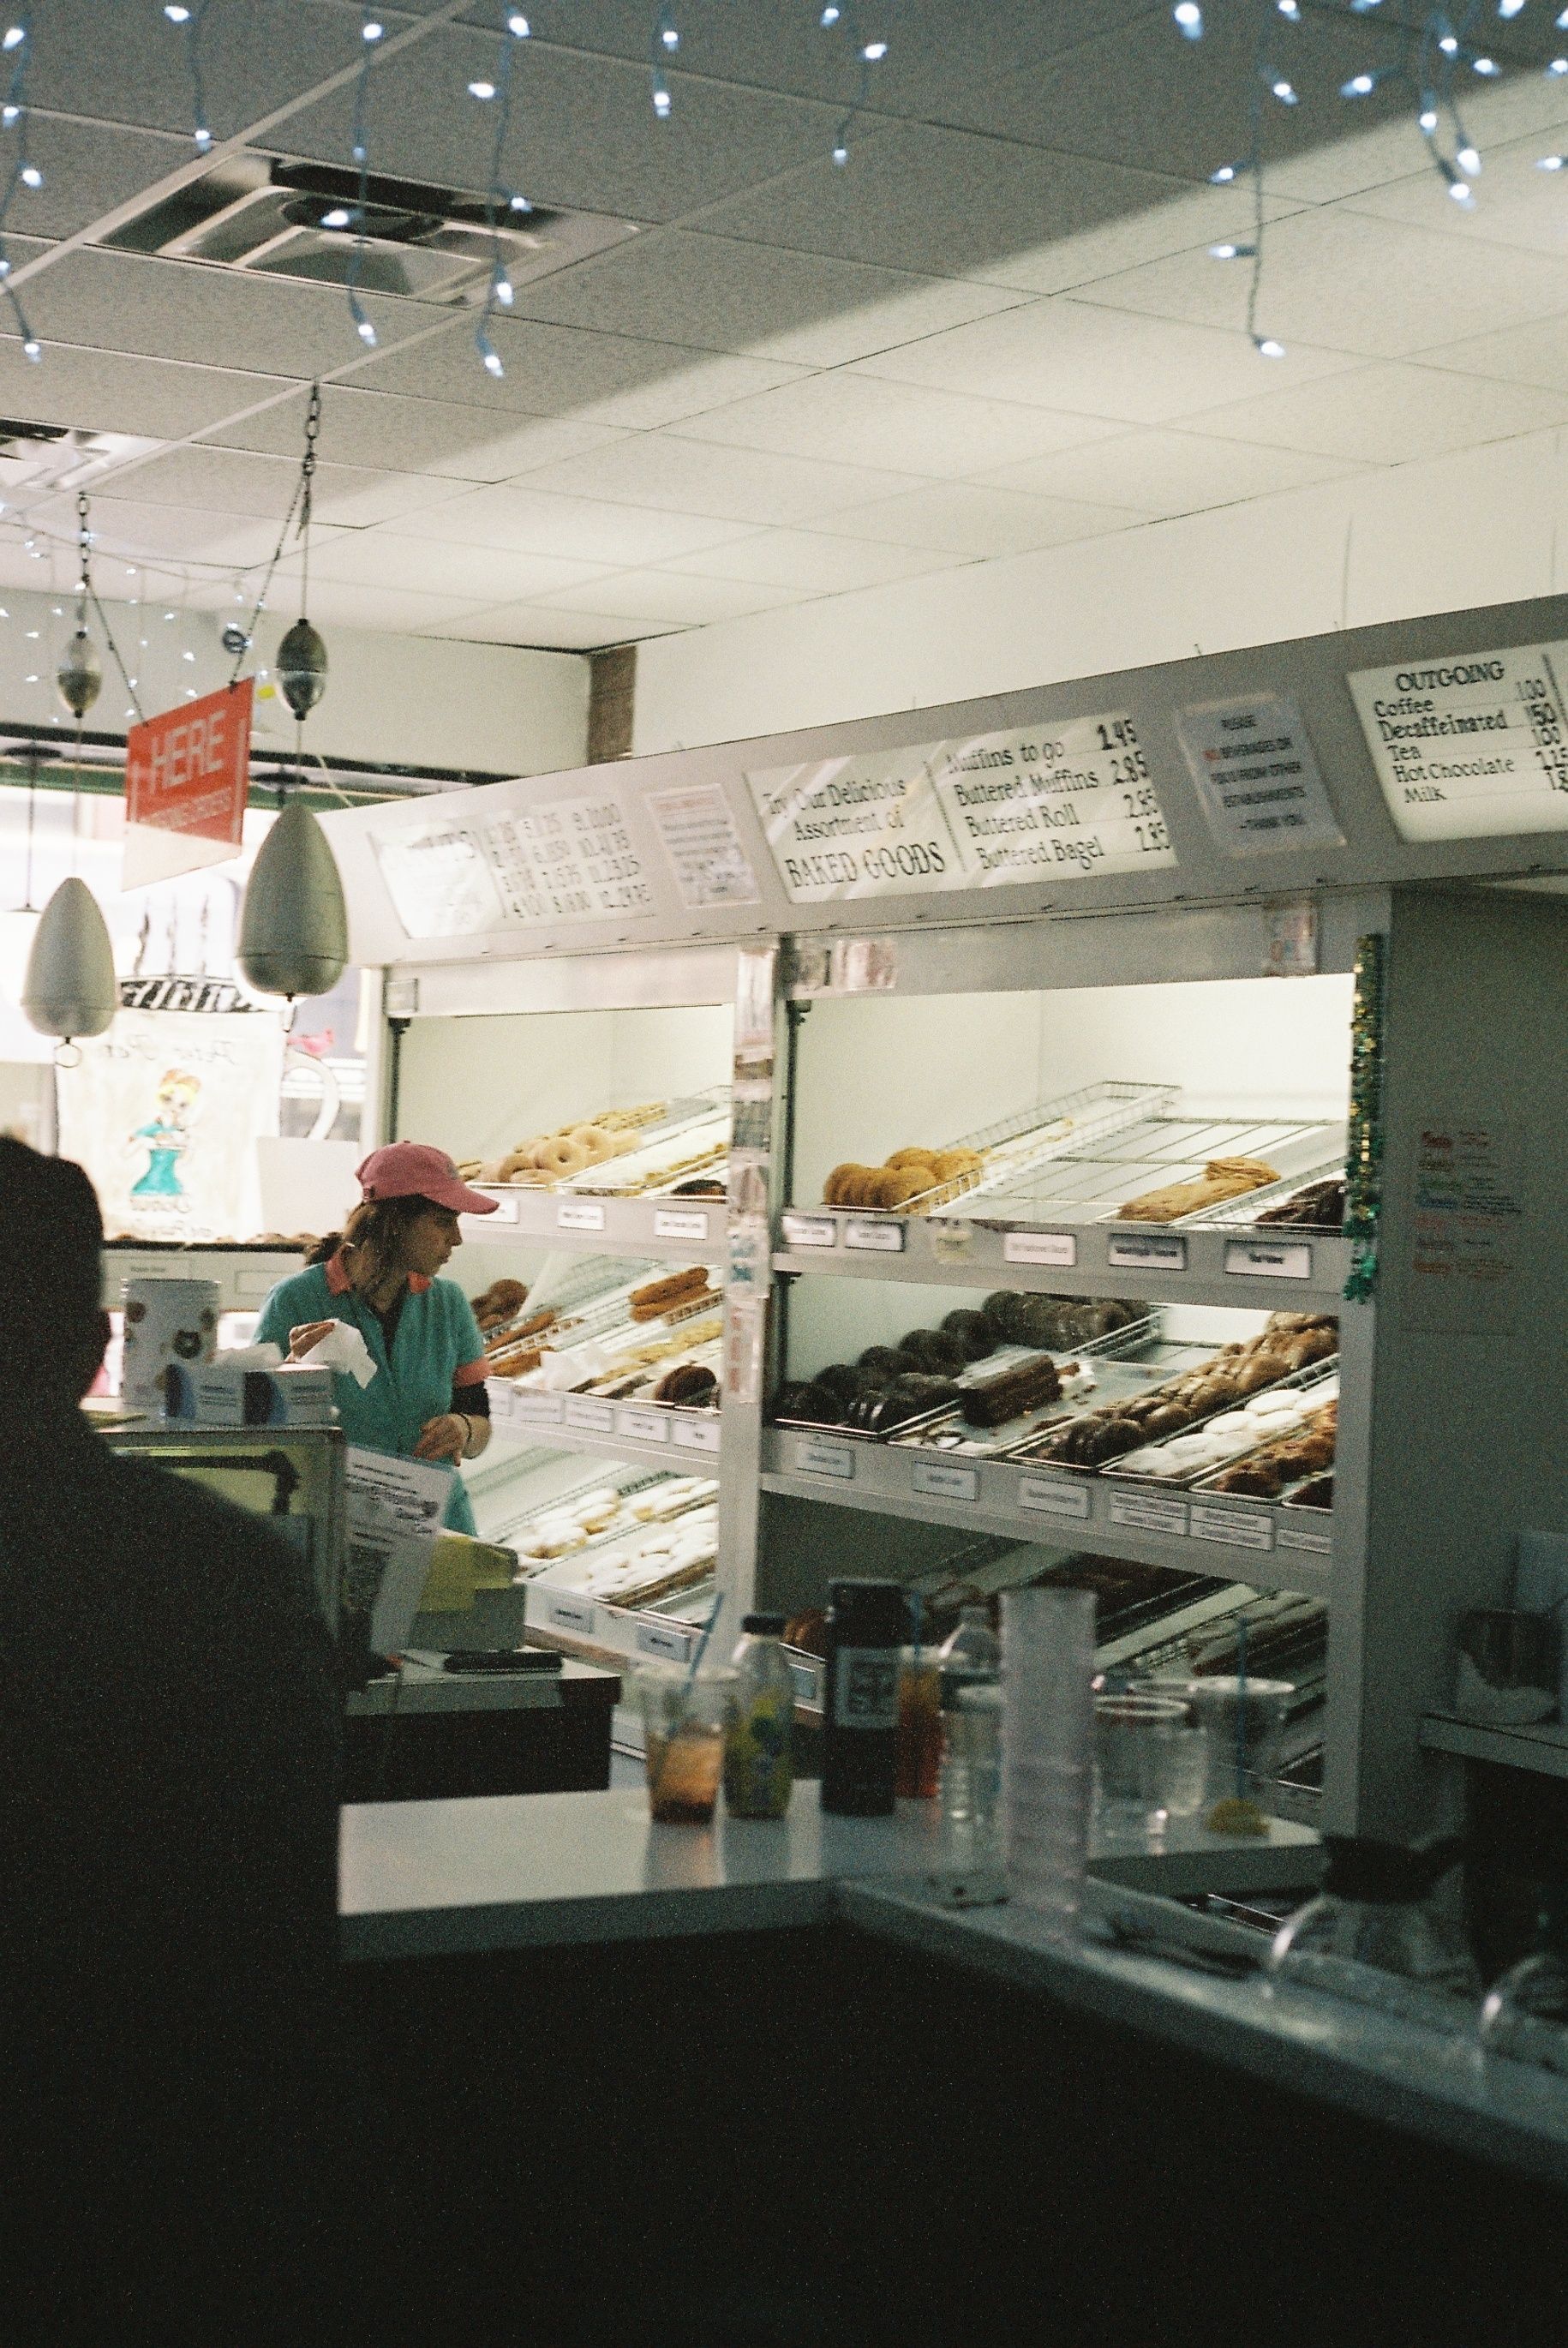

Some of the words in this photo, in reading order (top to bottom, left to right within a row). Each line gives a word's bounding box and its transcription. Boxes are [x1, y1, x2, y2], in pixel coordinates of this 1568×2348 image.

[1395, 661, 1505, 692] OUTGOING
[1374, 697, 1434, 717] Coffee
[1377, 708, 1508, 741] Decaffeinated
[149, 709, 226, 795] HERE
[946, 747, 1014, 774] Muffins
[1019, 744, 1039, 762] to
[1042, 741, 1065, 769] go
[1386, 744, 1421, 762] Tea
[1392, 764, 1427, 782] Hot
[1428, 758, 1516, 780] Chocolate
[826, 779, 907, 806] Delicious
[954, 775, 1029, 806] Buttered
[1029, 769, 1099, 797] Muffins
[1403, 786, 1448, 804] Milk
[794, 812, 883, 842] Assortment
[964, 809, 1039, 837] Buttered
[1039, 802, 1081, 829] Roll
[784, 850, 858, 889] BAKED
[861, 841, 946, 879] GOODS
[976, 841, 1052, 870] Buttered
[1050, 836, 1105, 871] Bagel
